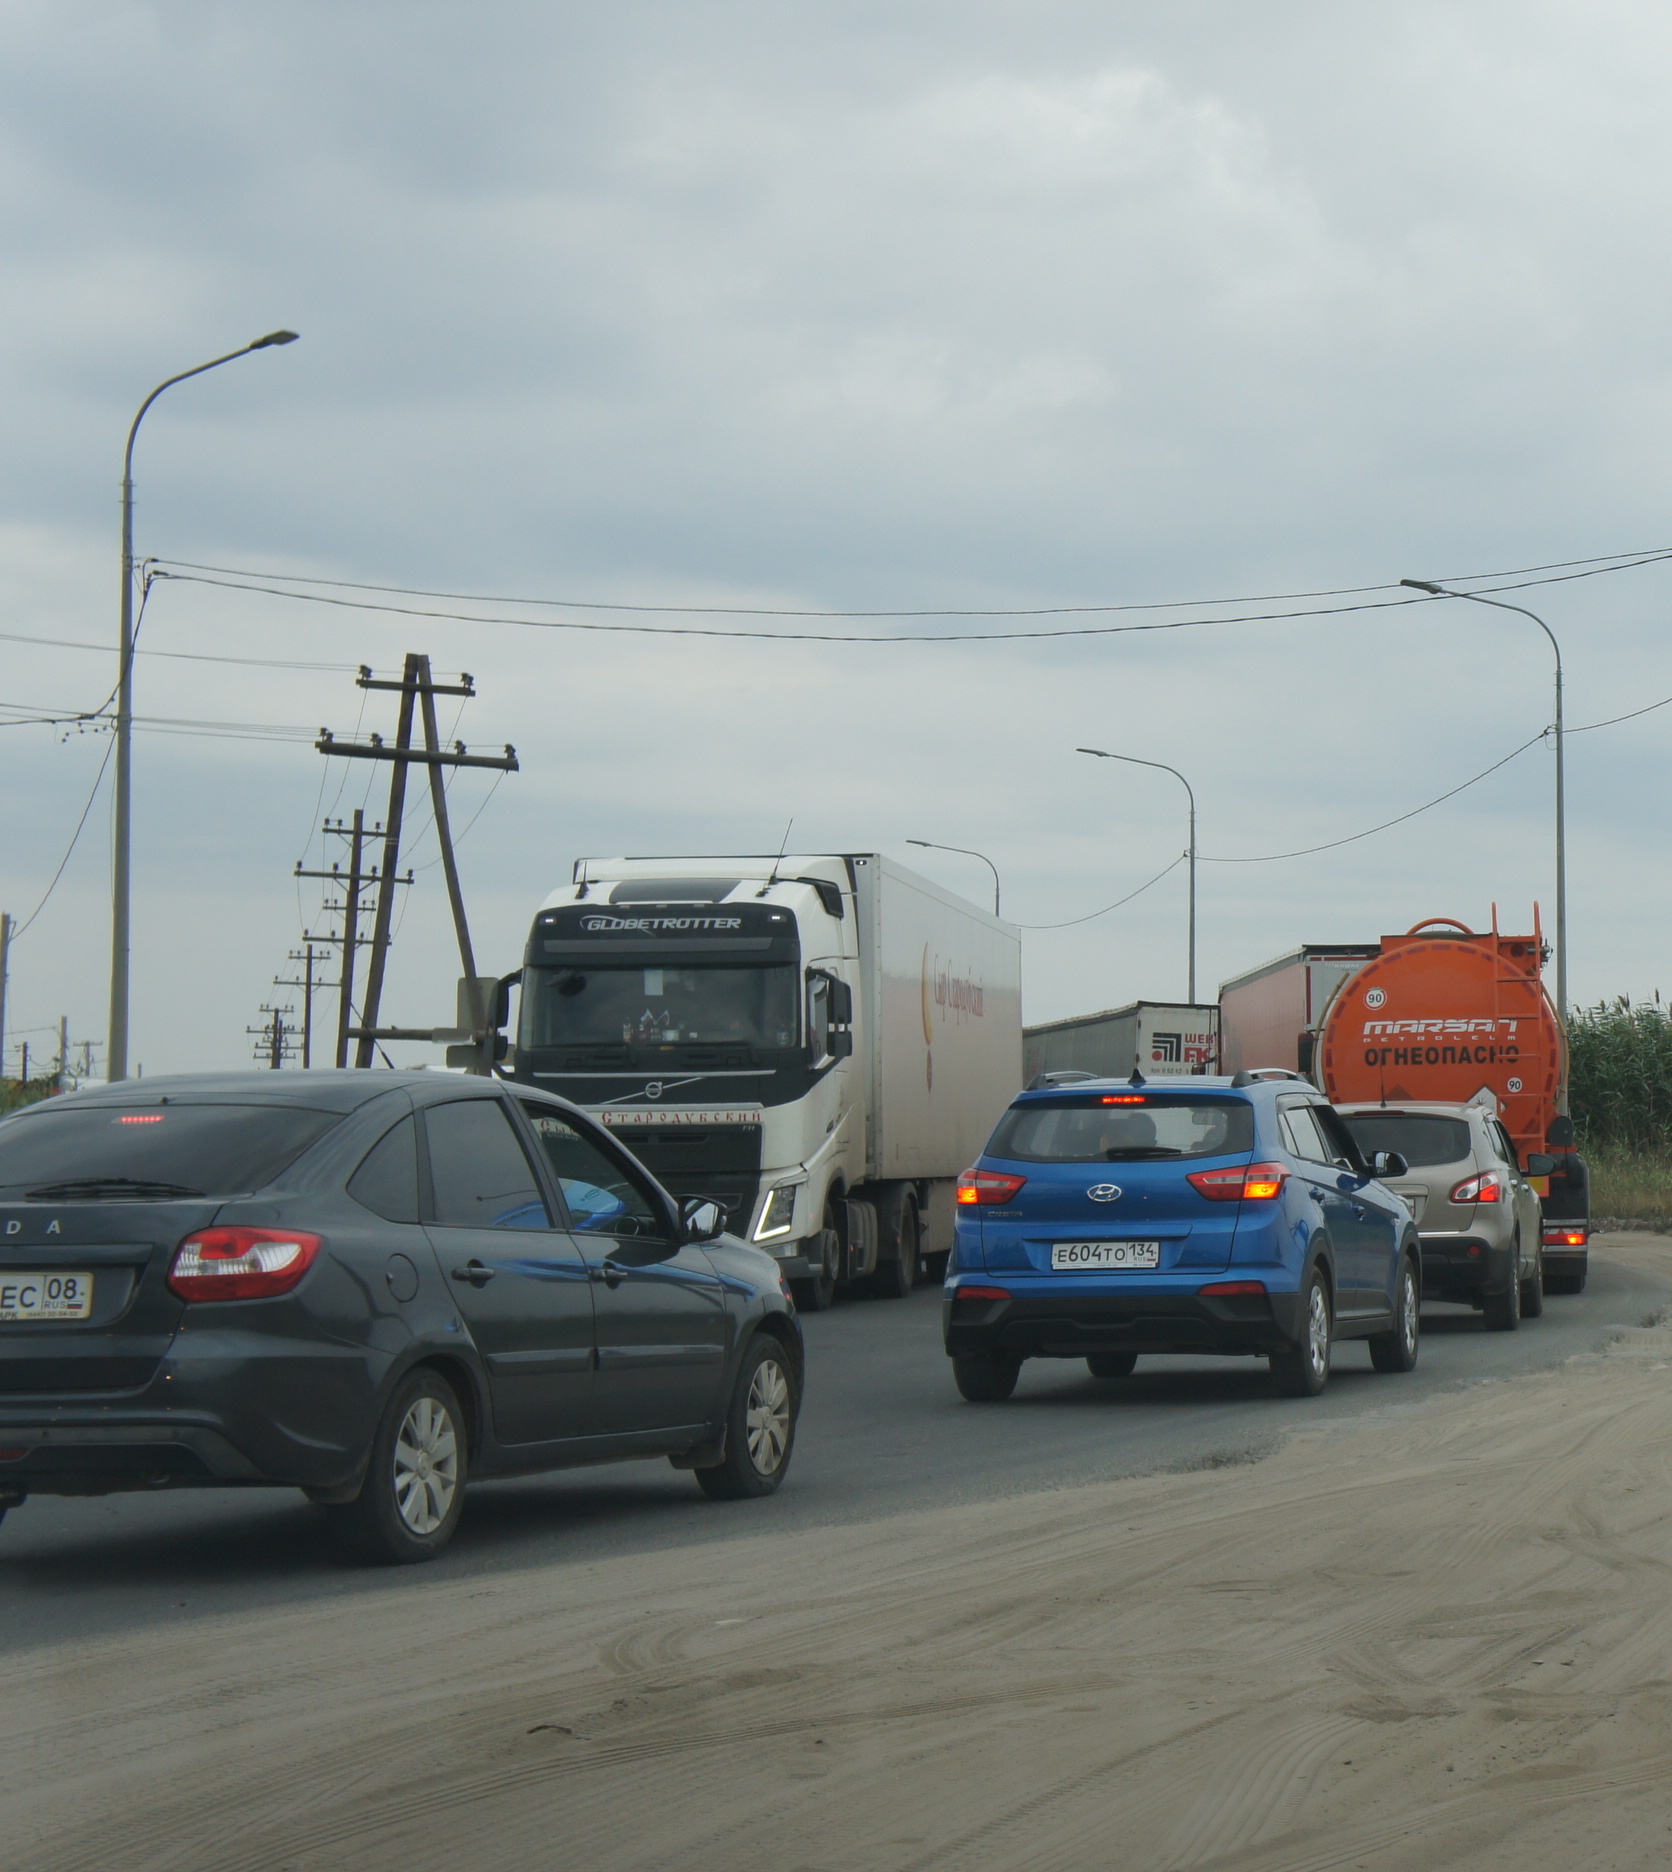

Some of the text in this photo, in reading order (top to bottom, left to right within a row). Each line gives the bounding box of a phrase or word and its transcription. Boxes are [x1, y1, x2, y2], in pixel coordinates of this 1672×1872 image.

[586, 917, 742, 931] GLOBETROTTER
[1368, 993, 1382, 1004] 90
[1364, 1044, 1520, 1067] ОГНЕОПАСНО
[1508, 1080, 1521, 1091] 90
[601, 1110, 762, 1126] Стародубский
[1129, 1243, 1154, 1257] 134
[47, 1278, 77, 1300] 08
[44, 1301, 67, 1309] RUS
